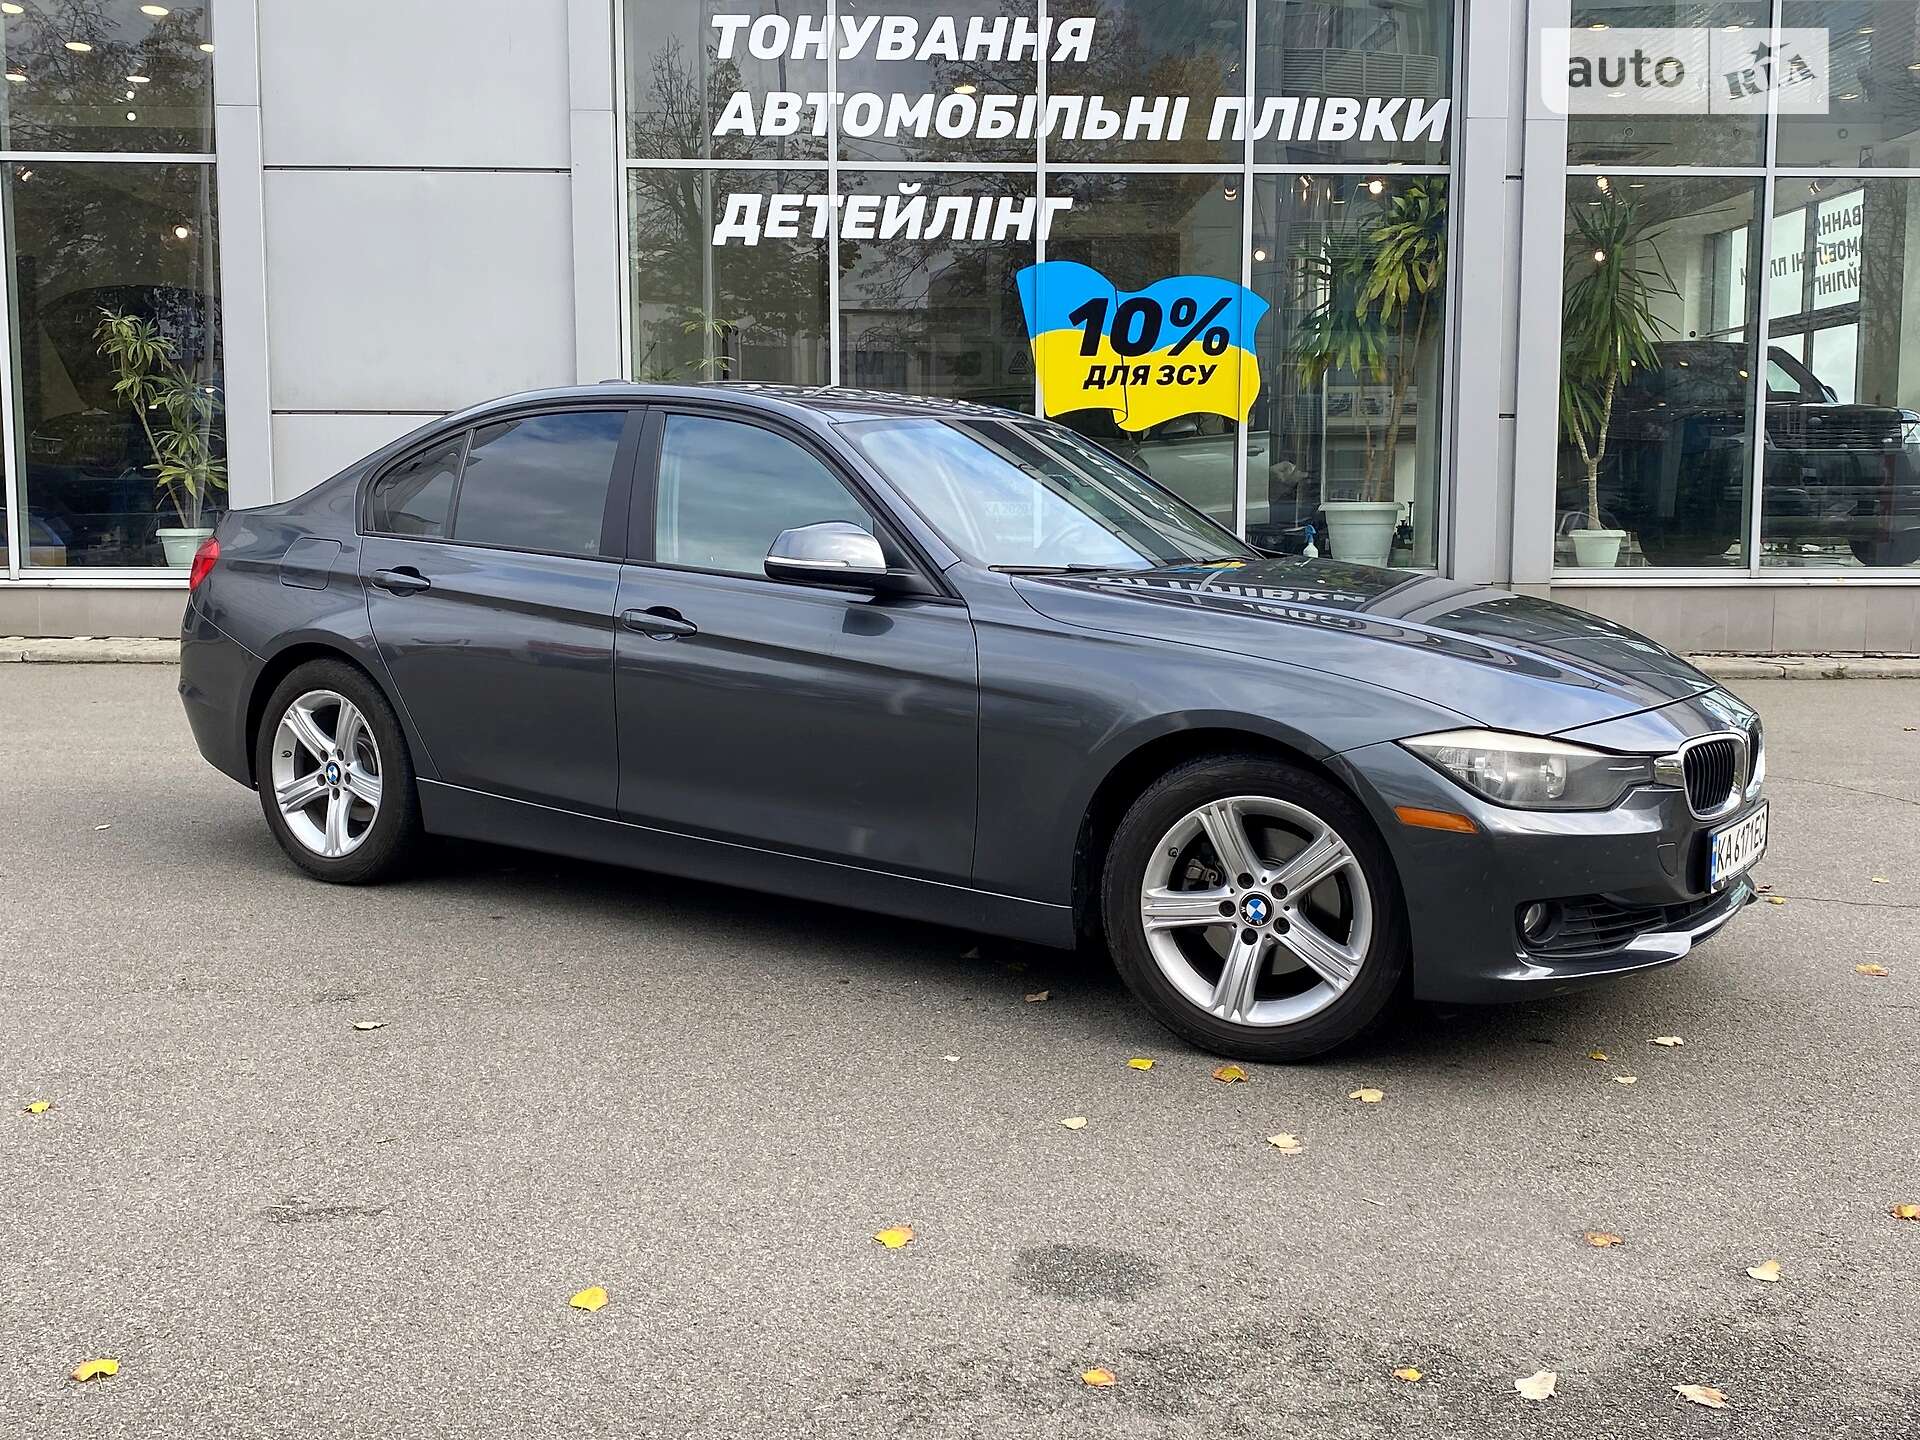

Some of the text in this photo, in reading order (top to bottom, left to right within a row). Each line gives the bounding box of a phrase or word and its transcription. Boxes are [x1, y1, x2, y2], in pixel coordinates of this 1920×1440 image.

[710, 13, 1097, 62] ТОНУВАННЯ
[711, 91, 1451, 142] АВТОМОБІЛЬНІ ПЛІВКИ
[711, 182, 1074, 246] ДЕТЕЙЛІНГ
[1068, 297, 1233, 357] 10%
[1082, 364, 1218, 390] ДЛЯ ЗСУ
